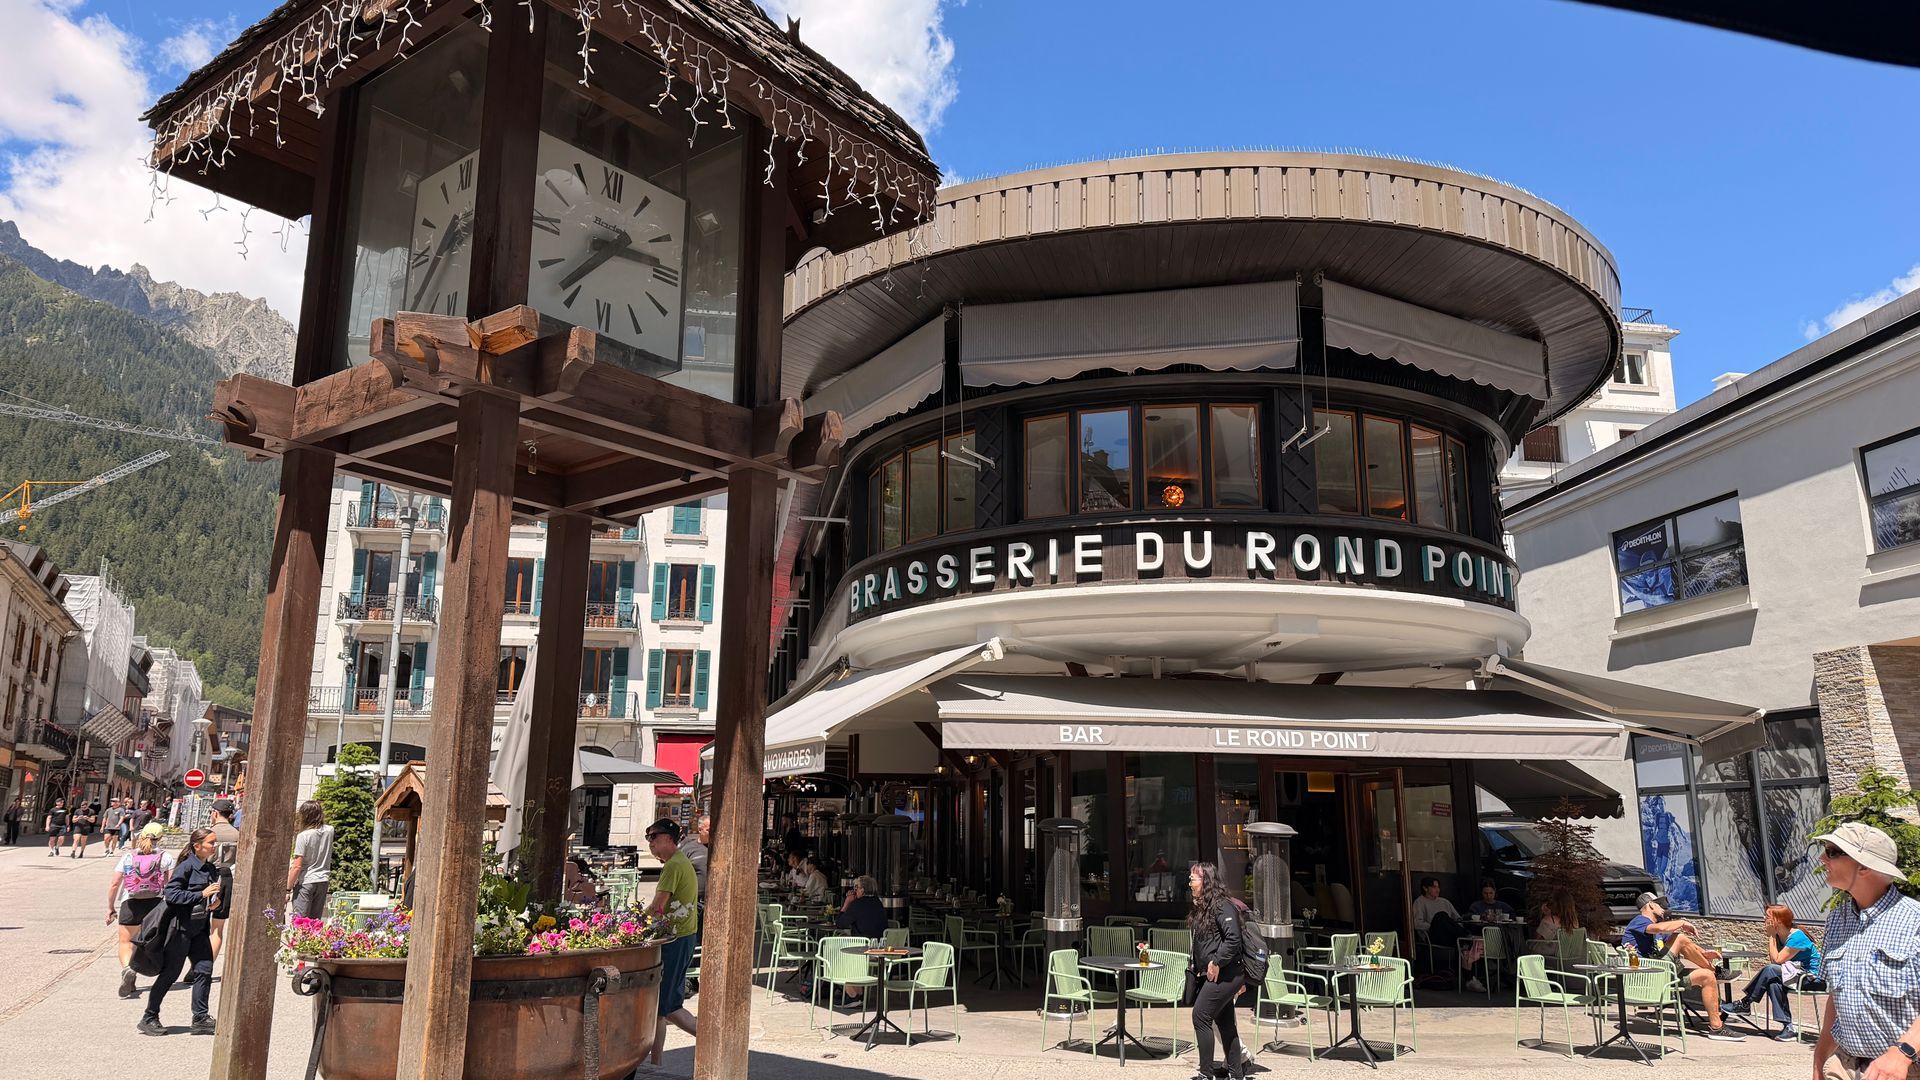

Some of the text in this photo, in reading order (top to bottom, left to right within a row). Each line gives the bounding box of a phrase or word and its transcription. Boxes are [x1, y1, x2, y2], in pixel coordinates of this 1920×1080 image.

[601, 166, 624, 204] XII
[592, 215, 626, 235] Bode
[595, 299, 611, 333] VI
[1628, 531, 1662, 548] DECATHLON
[850, 534, 1103, 614] BRASSERIE
[1135, 530, 1213, 571] DU
[1246, 531, 1402, 578] ROND
[1058, 725, 1105, 744] BAR
[1214, 728, 1370, 749] LE ROND POINT
[763, 748, 811, 770] AVOYARDES
[679, 786, 694, 795] SOU
